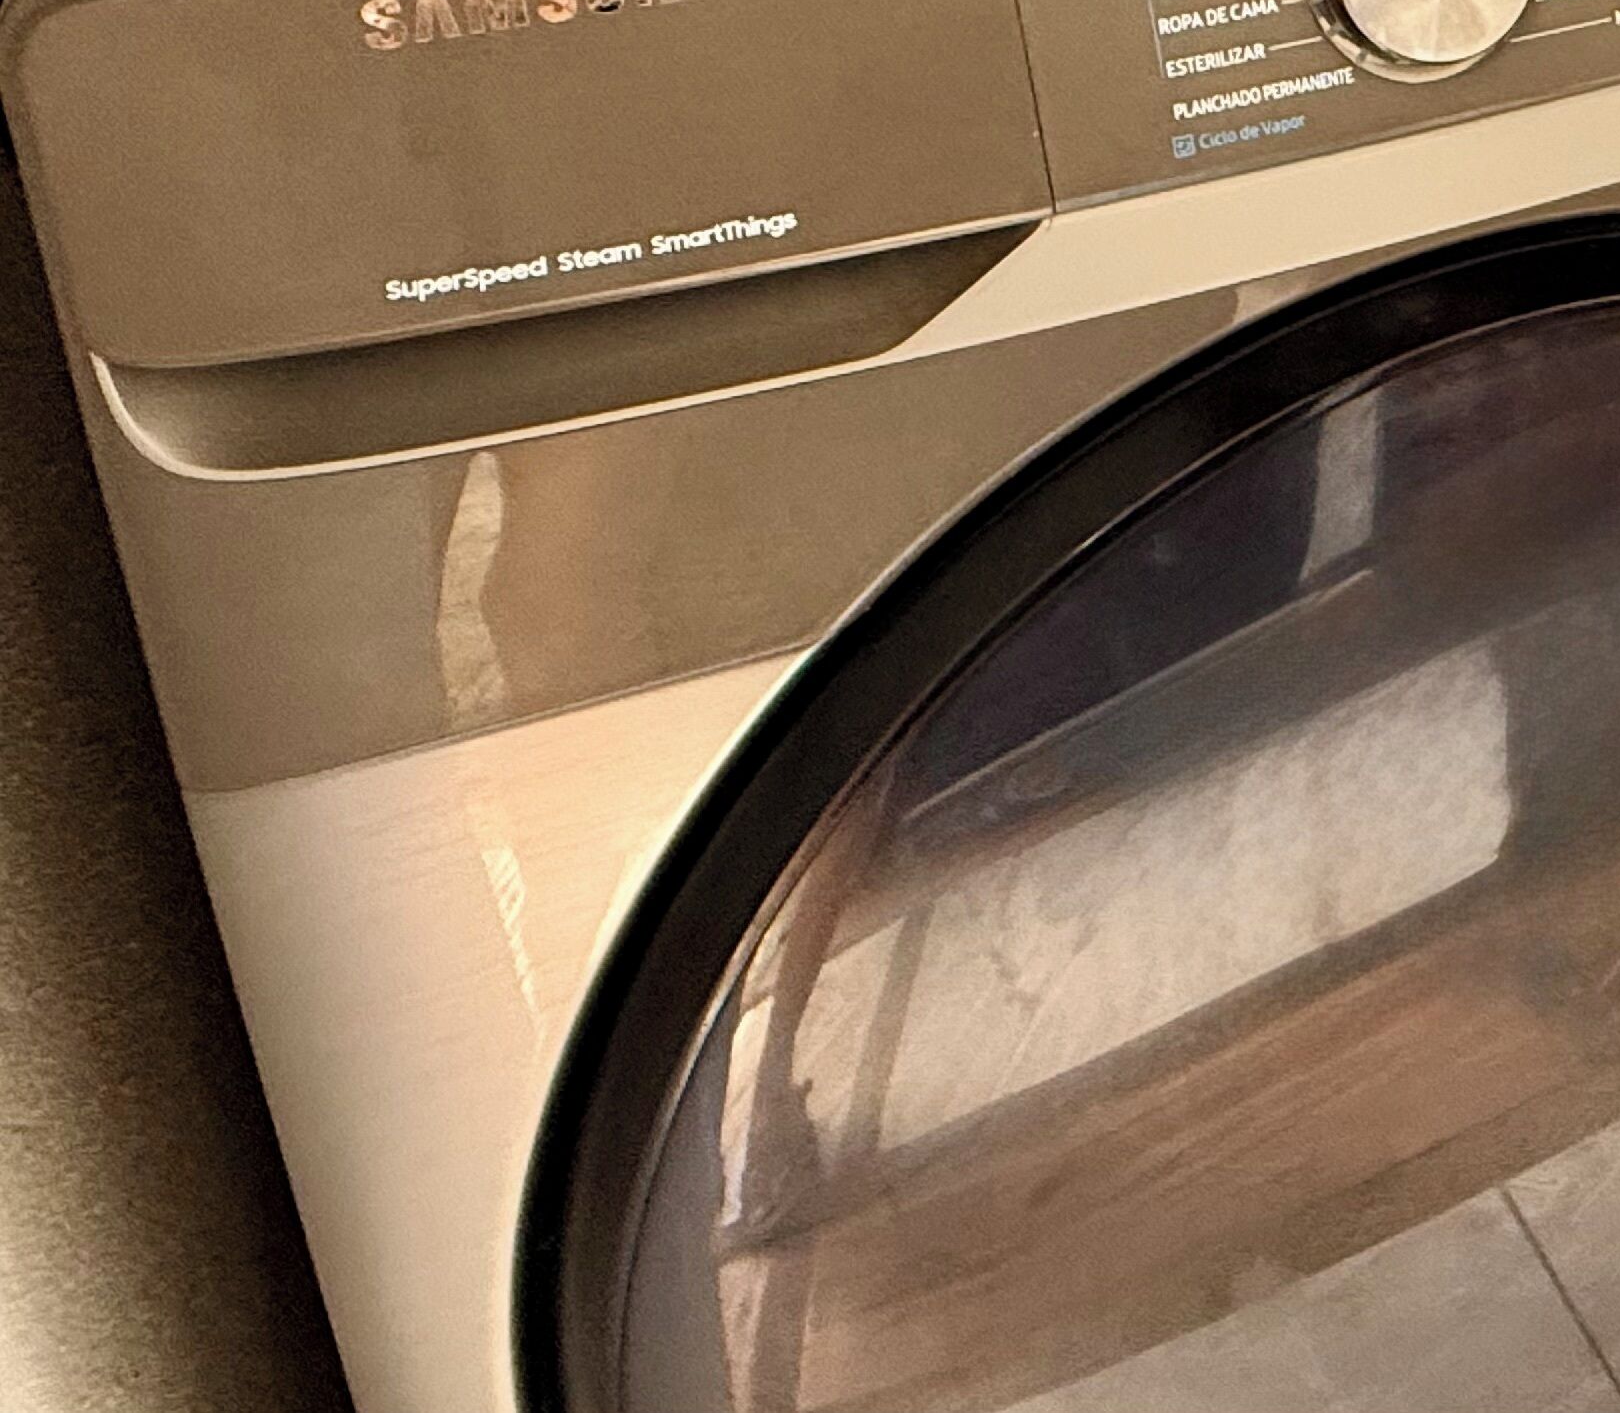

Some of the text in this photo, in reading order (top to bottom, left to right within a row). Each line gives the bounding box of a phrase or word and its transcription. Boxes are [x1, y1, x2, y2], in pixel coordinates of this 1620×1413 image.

[1157, 14, 1204, 35] ROPA
[1205, 6, 1228, 26] DE
[1165, 43, 1266, 78] ESTERILIZAR
[1173, 67, 1355, 120] PLANCHADO PERMANENTE
[1199, 114, 1306, 149] Ciclo de Vapor
[385, 211, 798, 301] SuperSpeed Steam SmartThings
